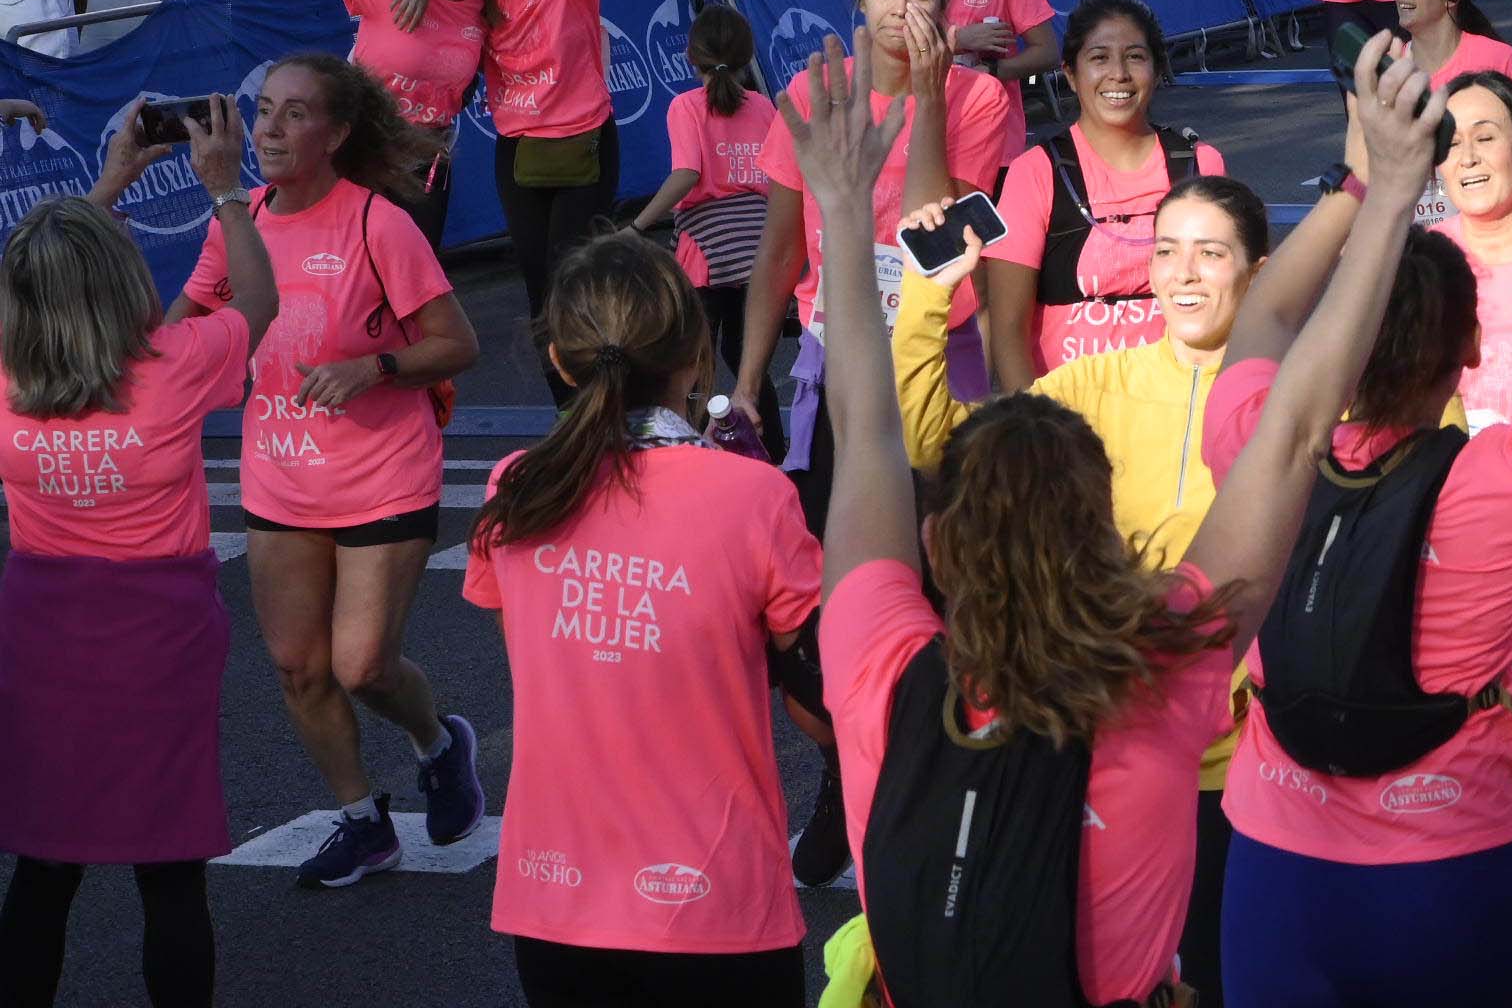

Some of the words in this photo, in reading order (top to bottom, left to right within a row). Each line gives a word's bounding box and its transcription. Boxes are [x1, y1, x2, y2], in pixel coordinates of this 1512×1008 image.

[1416, 201, 1446, 216] 016
[12, 426, 144, 452] CARRERA
[37, 453, 73, 474] DE
[83, 452, 119, 474] LA
[38, 474, 128, 496] MUJER
[72, 499, 96, 507] 2023
[534, 544, 692, 596] CARRERA
[562, 578, 604, 612] DE
[617, 586, 657, 620] LA
[1305, 571, 1321, 613] EVADICT
[552, 608, 661, 652] MUJER
[592, 649, 622, 663] 2023
[518, 858, 583, 887] OYSHO
[640, 879, 704, 895] ASTURIANA
[945, 864, 963, 918] EVADICT
